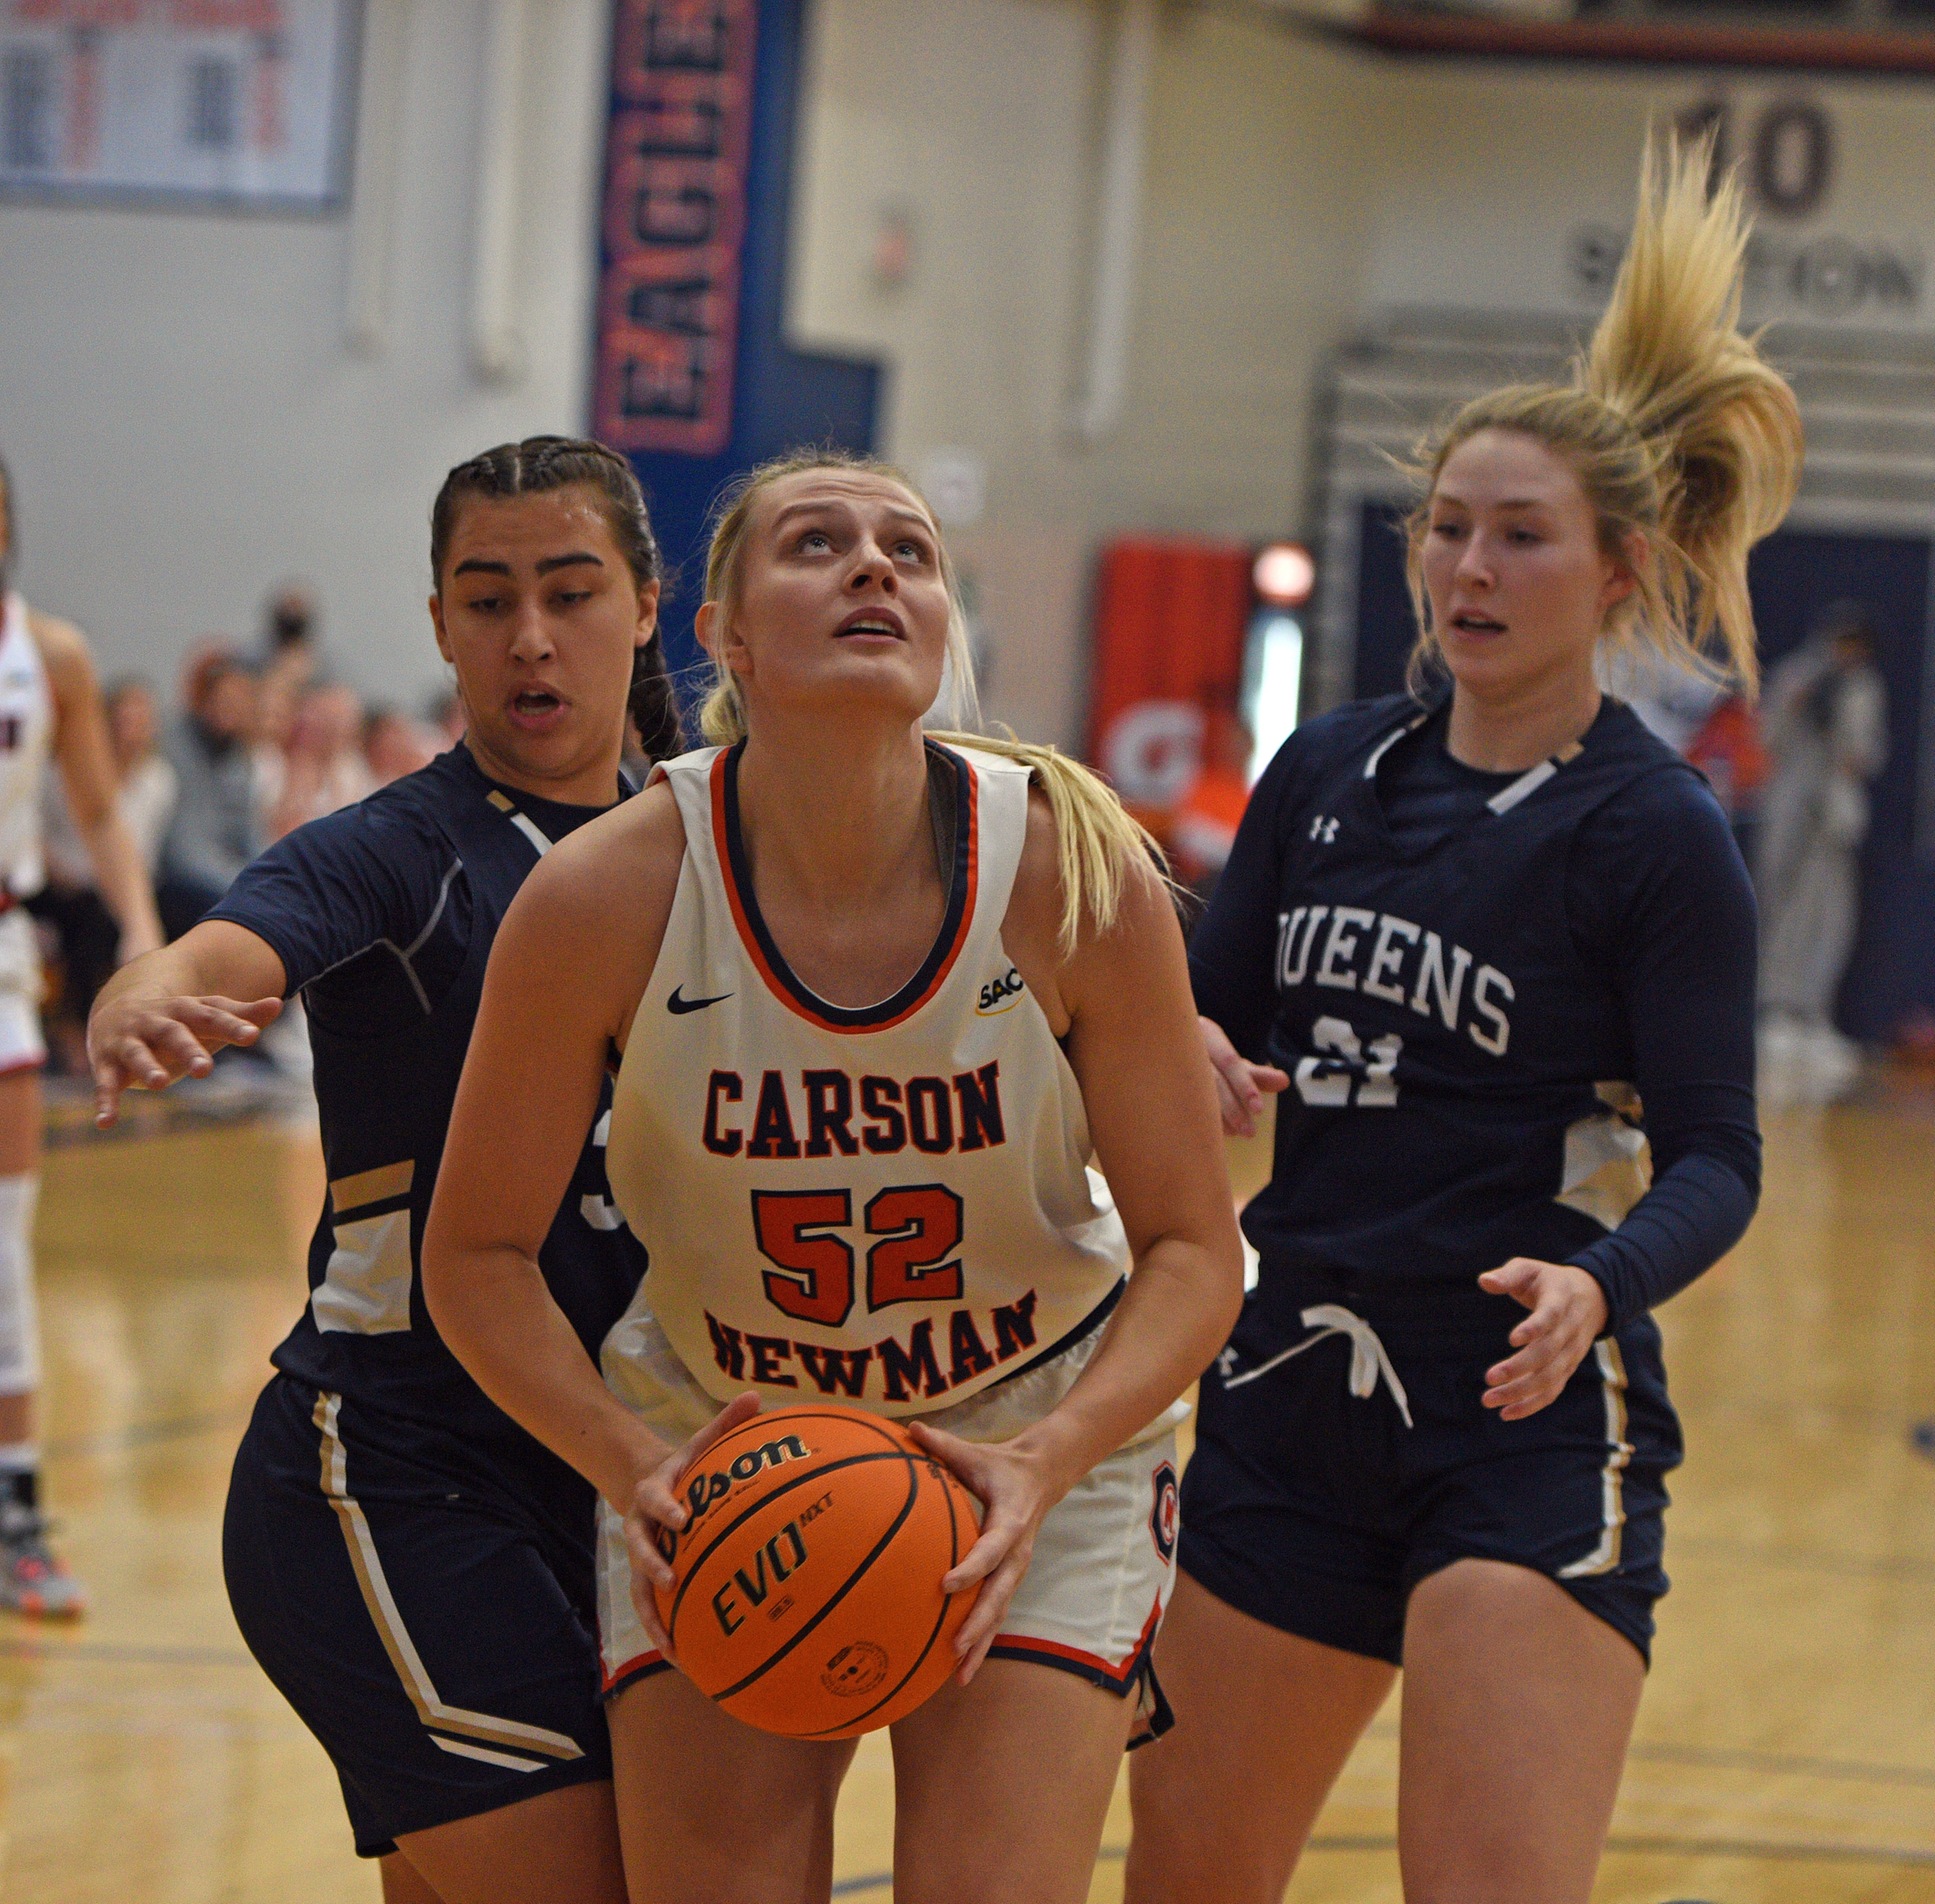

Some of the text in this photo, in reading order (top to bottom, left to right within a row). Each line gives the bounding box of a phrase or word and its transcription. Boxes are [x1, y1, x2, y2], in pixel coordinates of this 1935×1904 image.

[978, 967, 1024, 1010] SAC
[1275, 904, 1517, 1057] UEENS
[702, 1060, 1008, 1160] CARSON
[1295, 1014, 1404, 1107] 21
[750, 1182, 966, 1329] 52
[703, 1288, 1039, 1403] NEWMAN
[658, 1434, 812, 1567] lson
[711, 1520, 808, 1638] EVO
